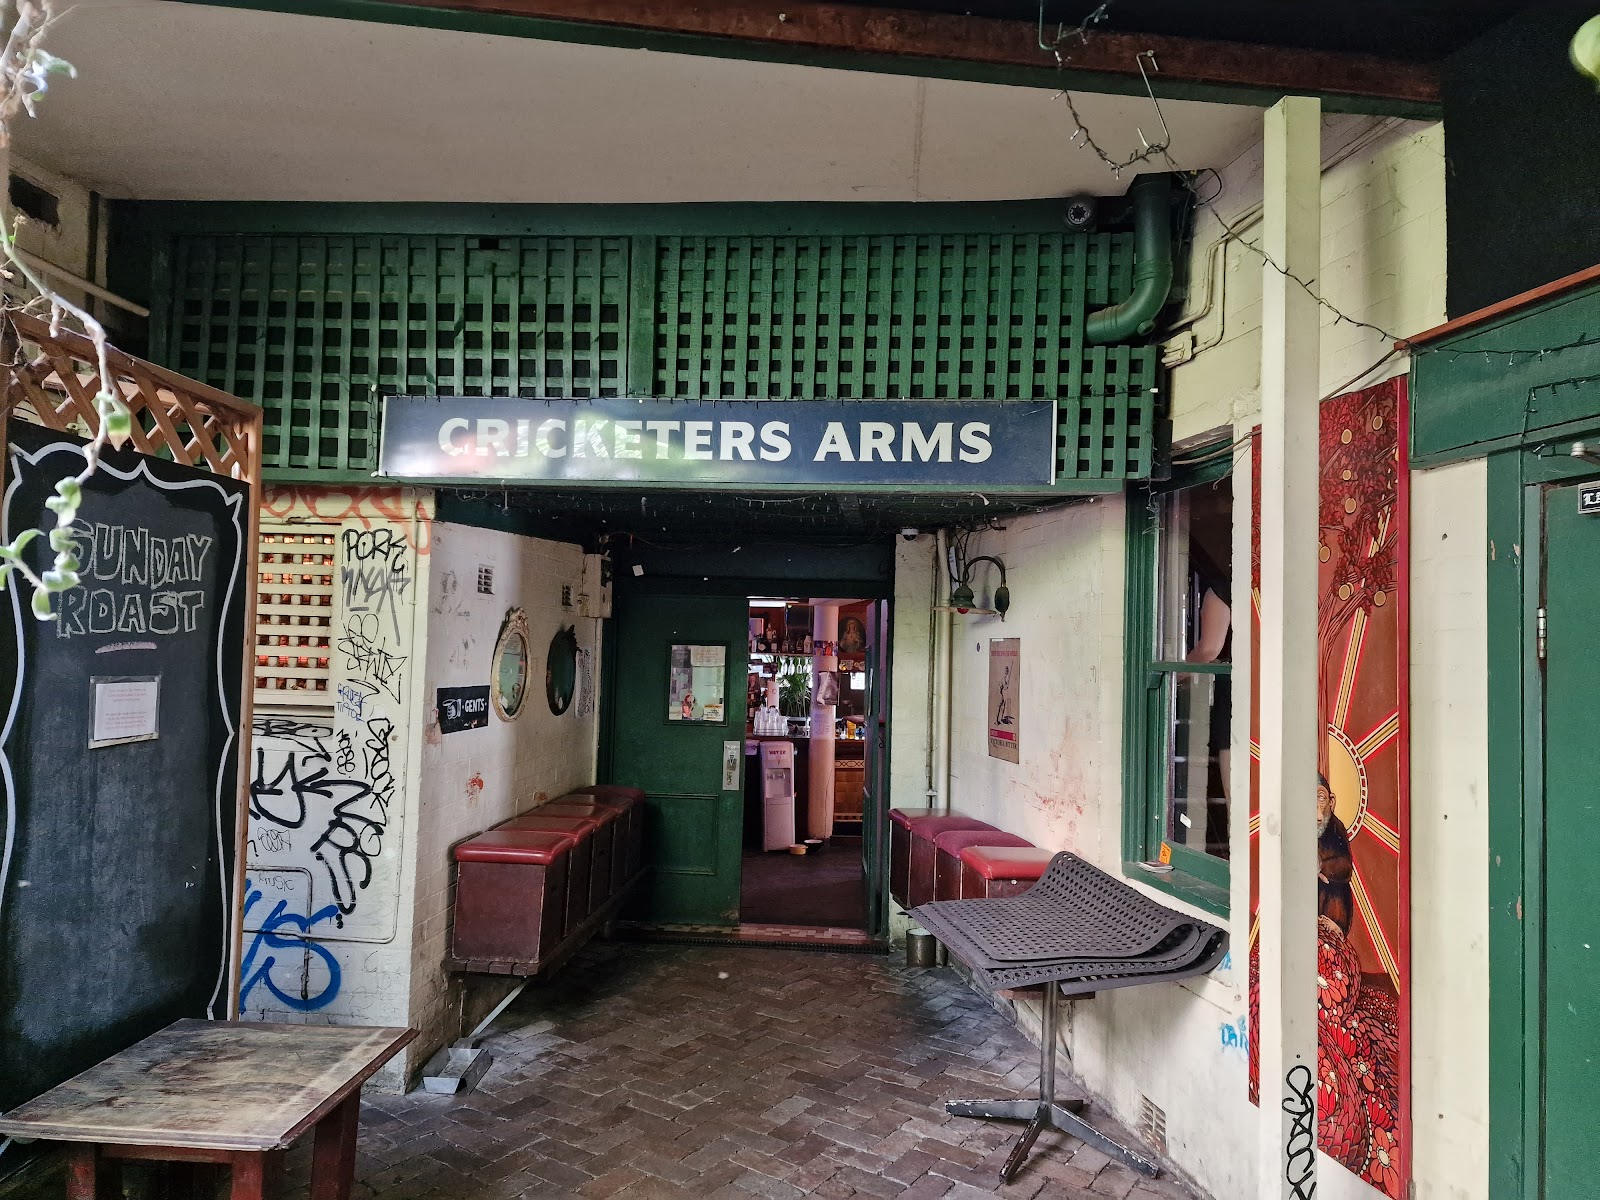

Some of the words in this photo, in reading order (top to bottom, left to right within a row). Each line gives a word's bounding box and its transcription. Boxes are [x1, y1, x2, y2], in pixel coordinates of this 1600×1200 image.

[438, 417, 792, 462] CRICKETERS
[813, 420, 993, 463] ARMS
[70, 517, 213, 590] SUNDAY
[56, 585, 204, 639] ROAST
[464, 698, 485, 713] GENTS
